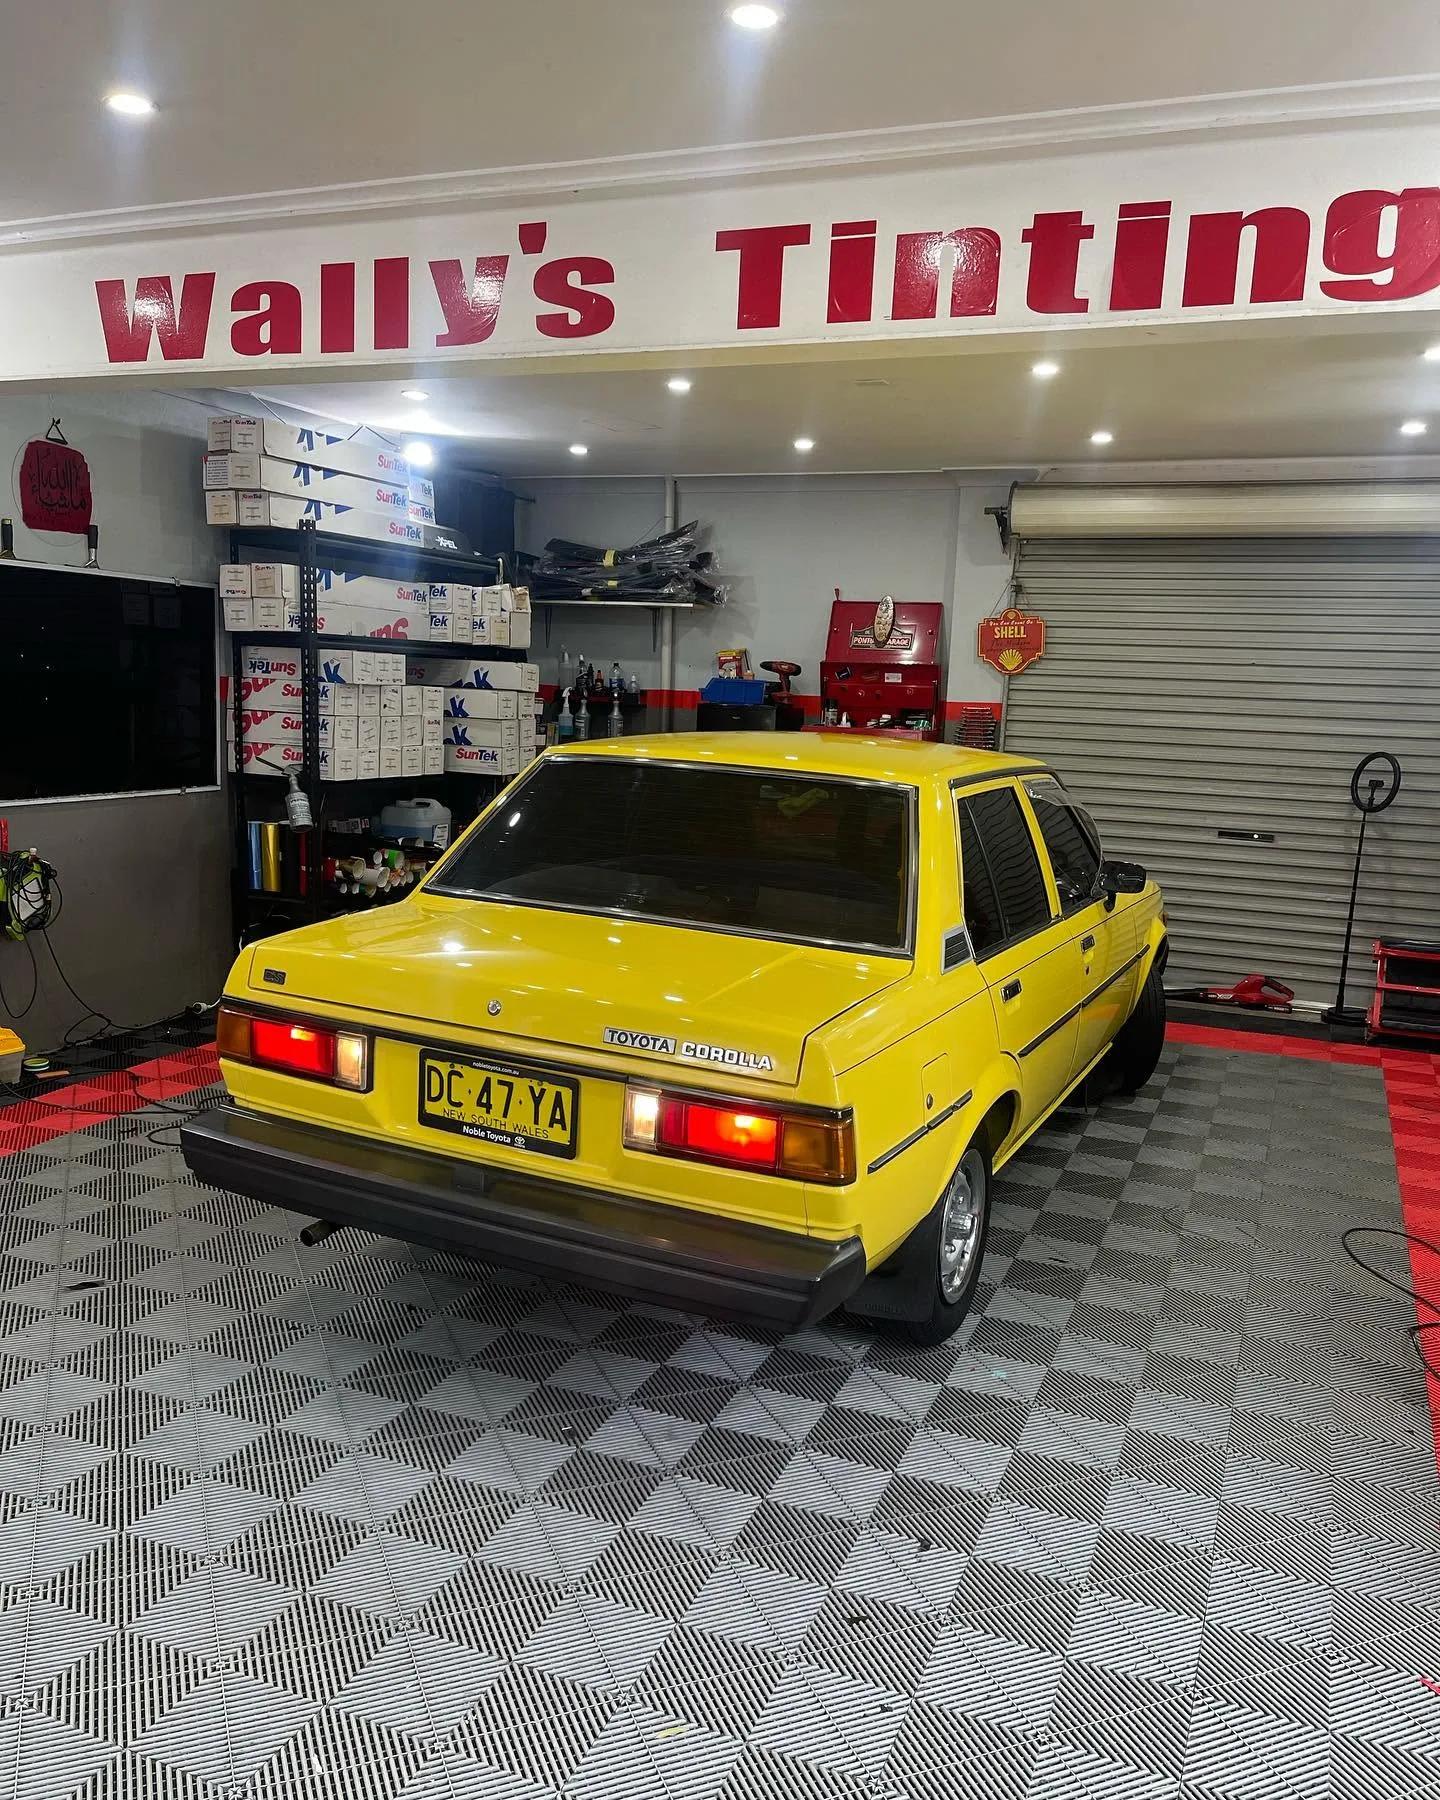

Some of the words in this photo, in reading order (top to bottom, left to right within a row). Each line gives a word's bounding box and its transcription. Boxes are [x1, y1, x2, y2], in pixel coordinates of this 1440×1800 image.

[96, 222, 616, 362] Wally's
[716, 187, 1440, 329] Tinting
[378, 454, 408, 474] SunTek
[376, 488, 407, 508] SunTek
[409, 503, 433, 519] SunTek
[389, 521, 422, 541] SunTek
[396, 586, 428, 603] SunTek
[887, 637, 910, 646] ARAGE
[994, 625, 1027, 639] SHELL
[248, 660, 297, 676] SunTek
[455, 747, 498, 761] SunTek
[608, 1029, 670, 1052] TOYOTA
[681, 1041, 773, 1071] COROLLA
[472, 1061, 520, 1076] nobletoyota.com.au
[426, 1064, 464, 1108] DC
[476, 1076, 514, 1119] 47
[528, 1084, 567, 1131] YA
[443, 1107, 467, 1121] NEW
[470, 1113, 507, 1131] SOUTH
[512, 1122, 549, 1139] WALES
[462, 1124, 486, 1138] Noble
[486, 1130, 511, 1144] Toyota
